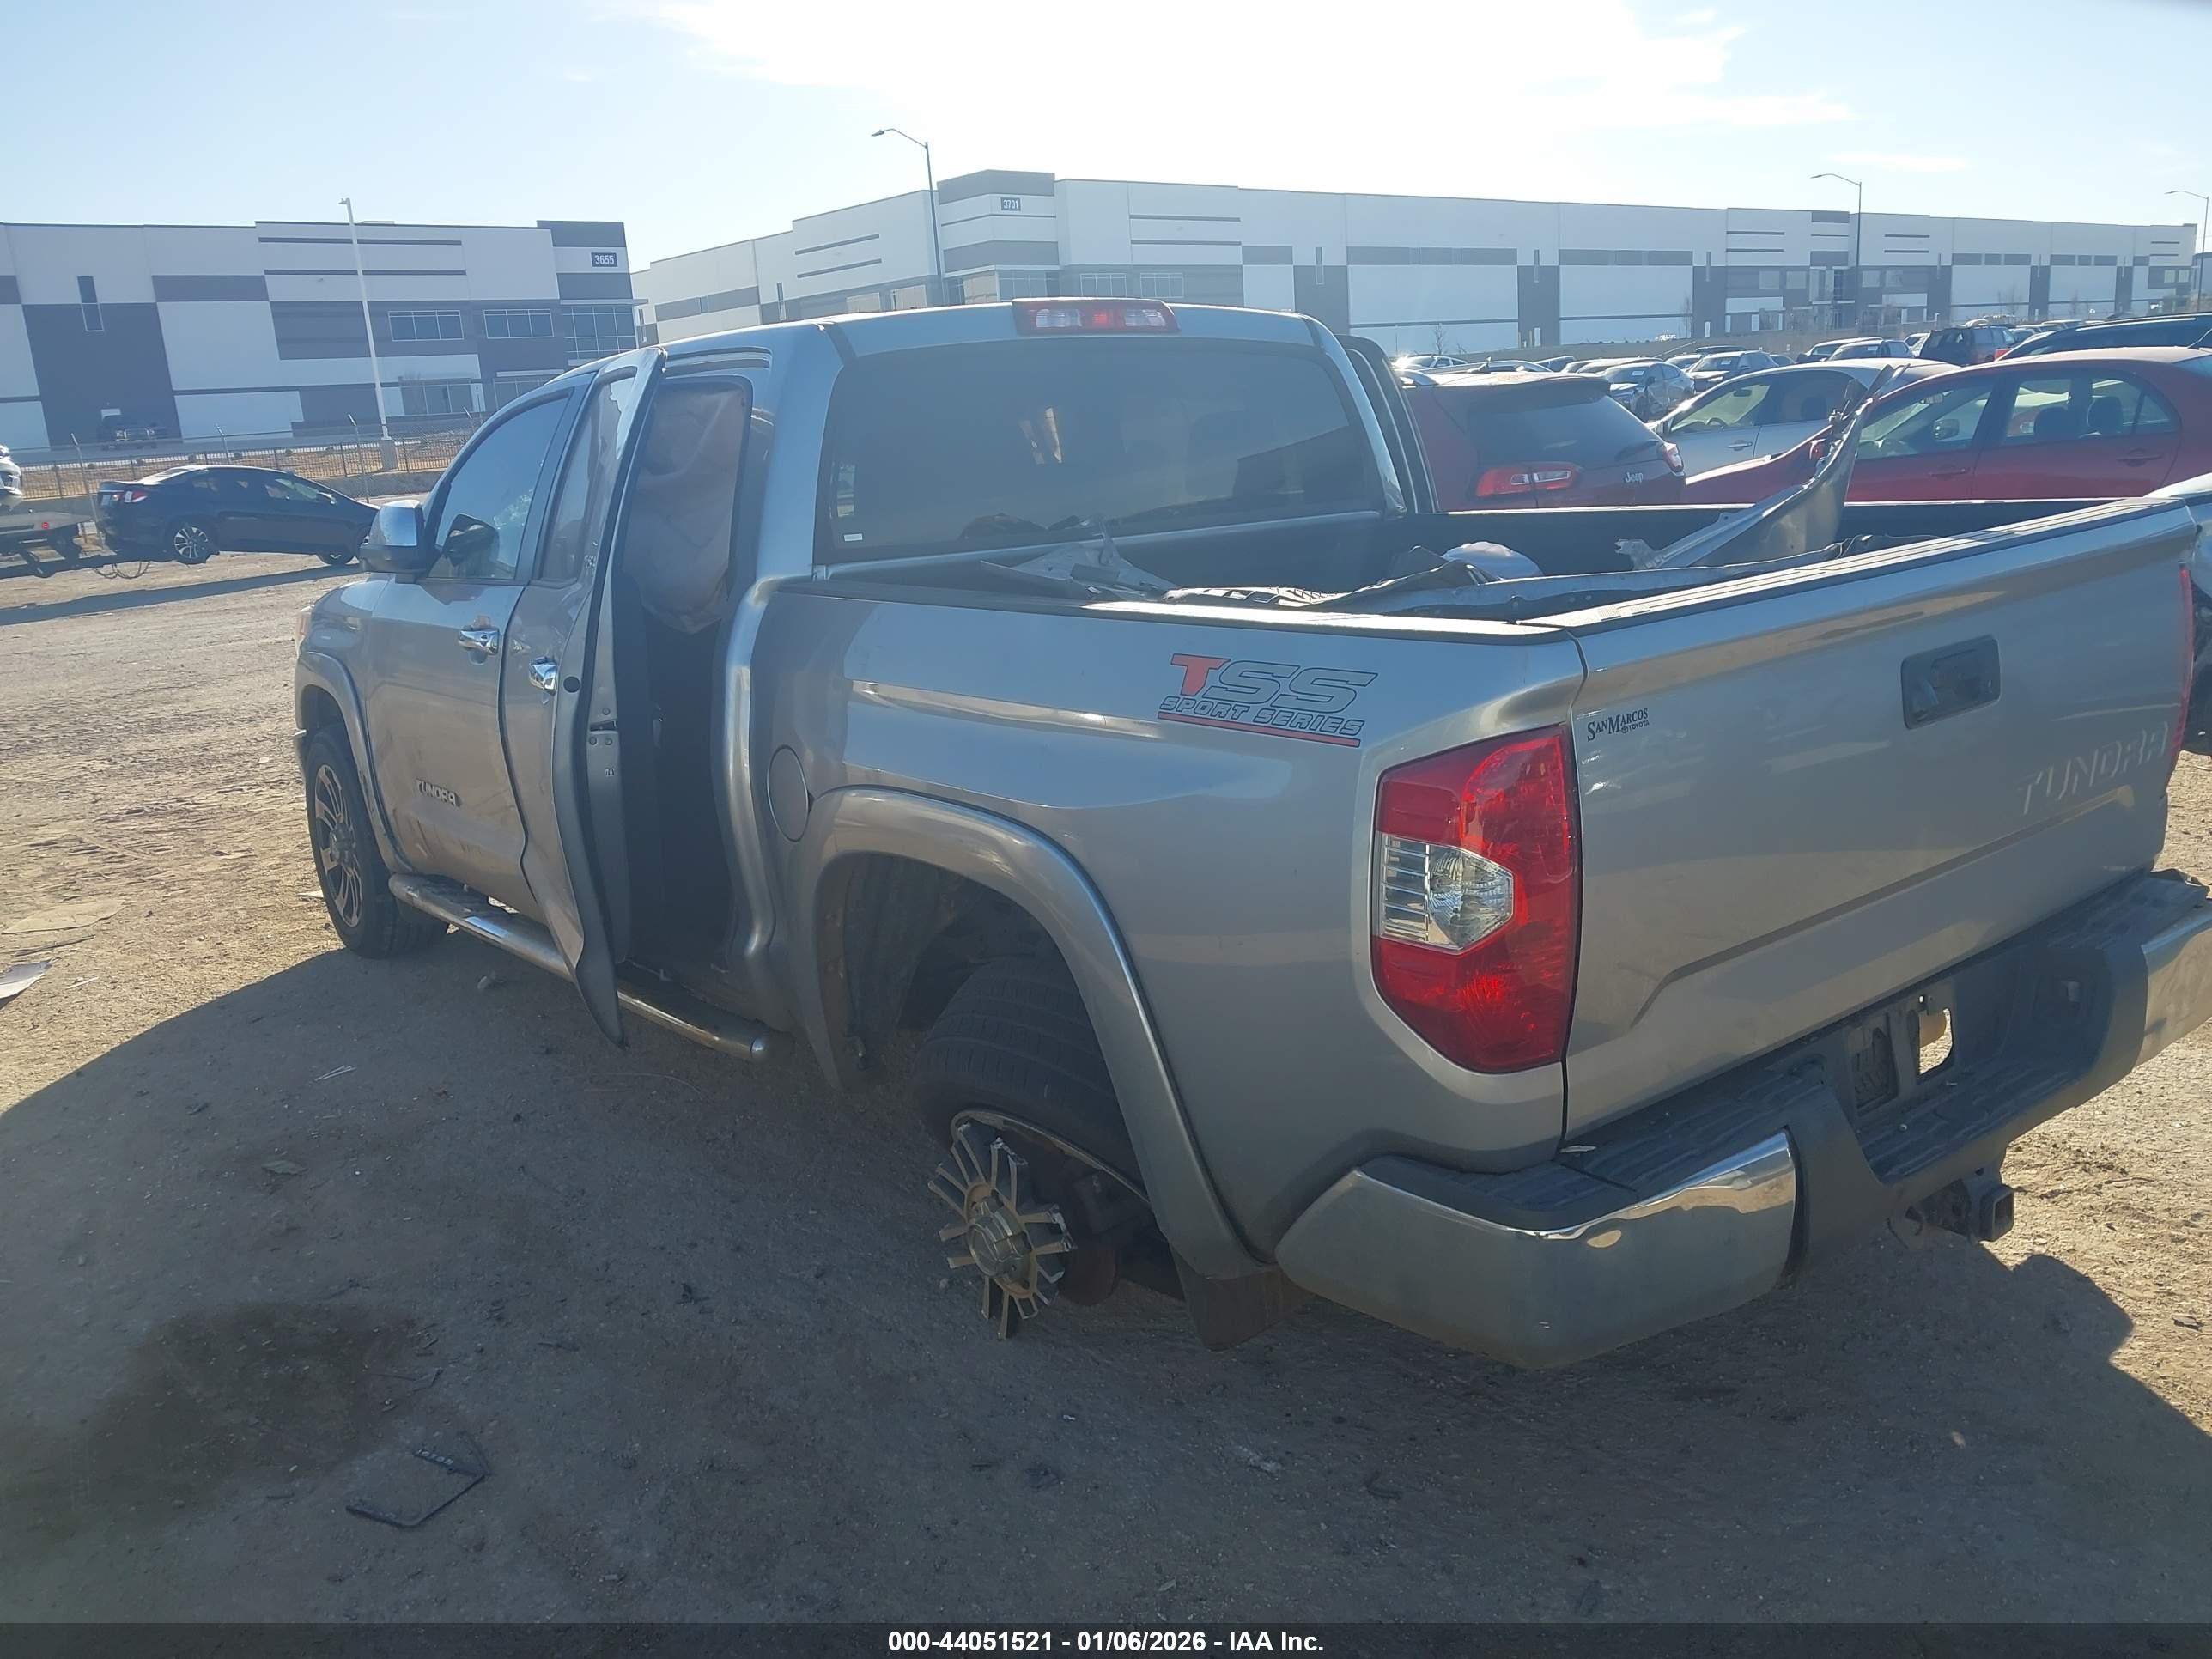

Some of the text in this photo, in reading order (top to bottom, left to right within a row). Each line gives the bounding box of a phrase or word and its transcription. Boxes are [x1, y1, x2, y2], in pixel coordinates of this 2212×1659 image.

[1003, 199, 1018, 210] 3701
[594, 254, 615, 265] 3655
[1625, 471, 1644, 484] Jeep
[1170, 653, 1378, 714] TSS
[1159, 696, 1365, 736] SPORT SERIES
[1628, 720, 1650, 731] TOYOTA
[2016, 720, 2170, 816] TUNDRA
[416, 778, 459, 808] TUNDRA
